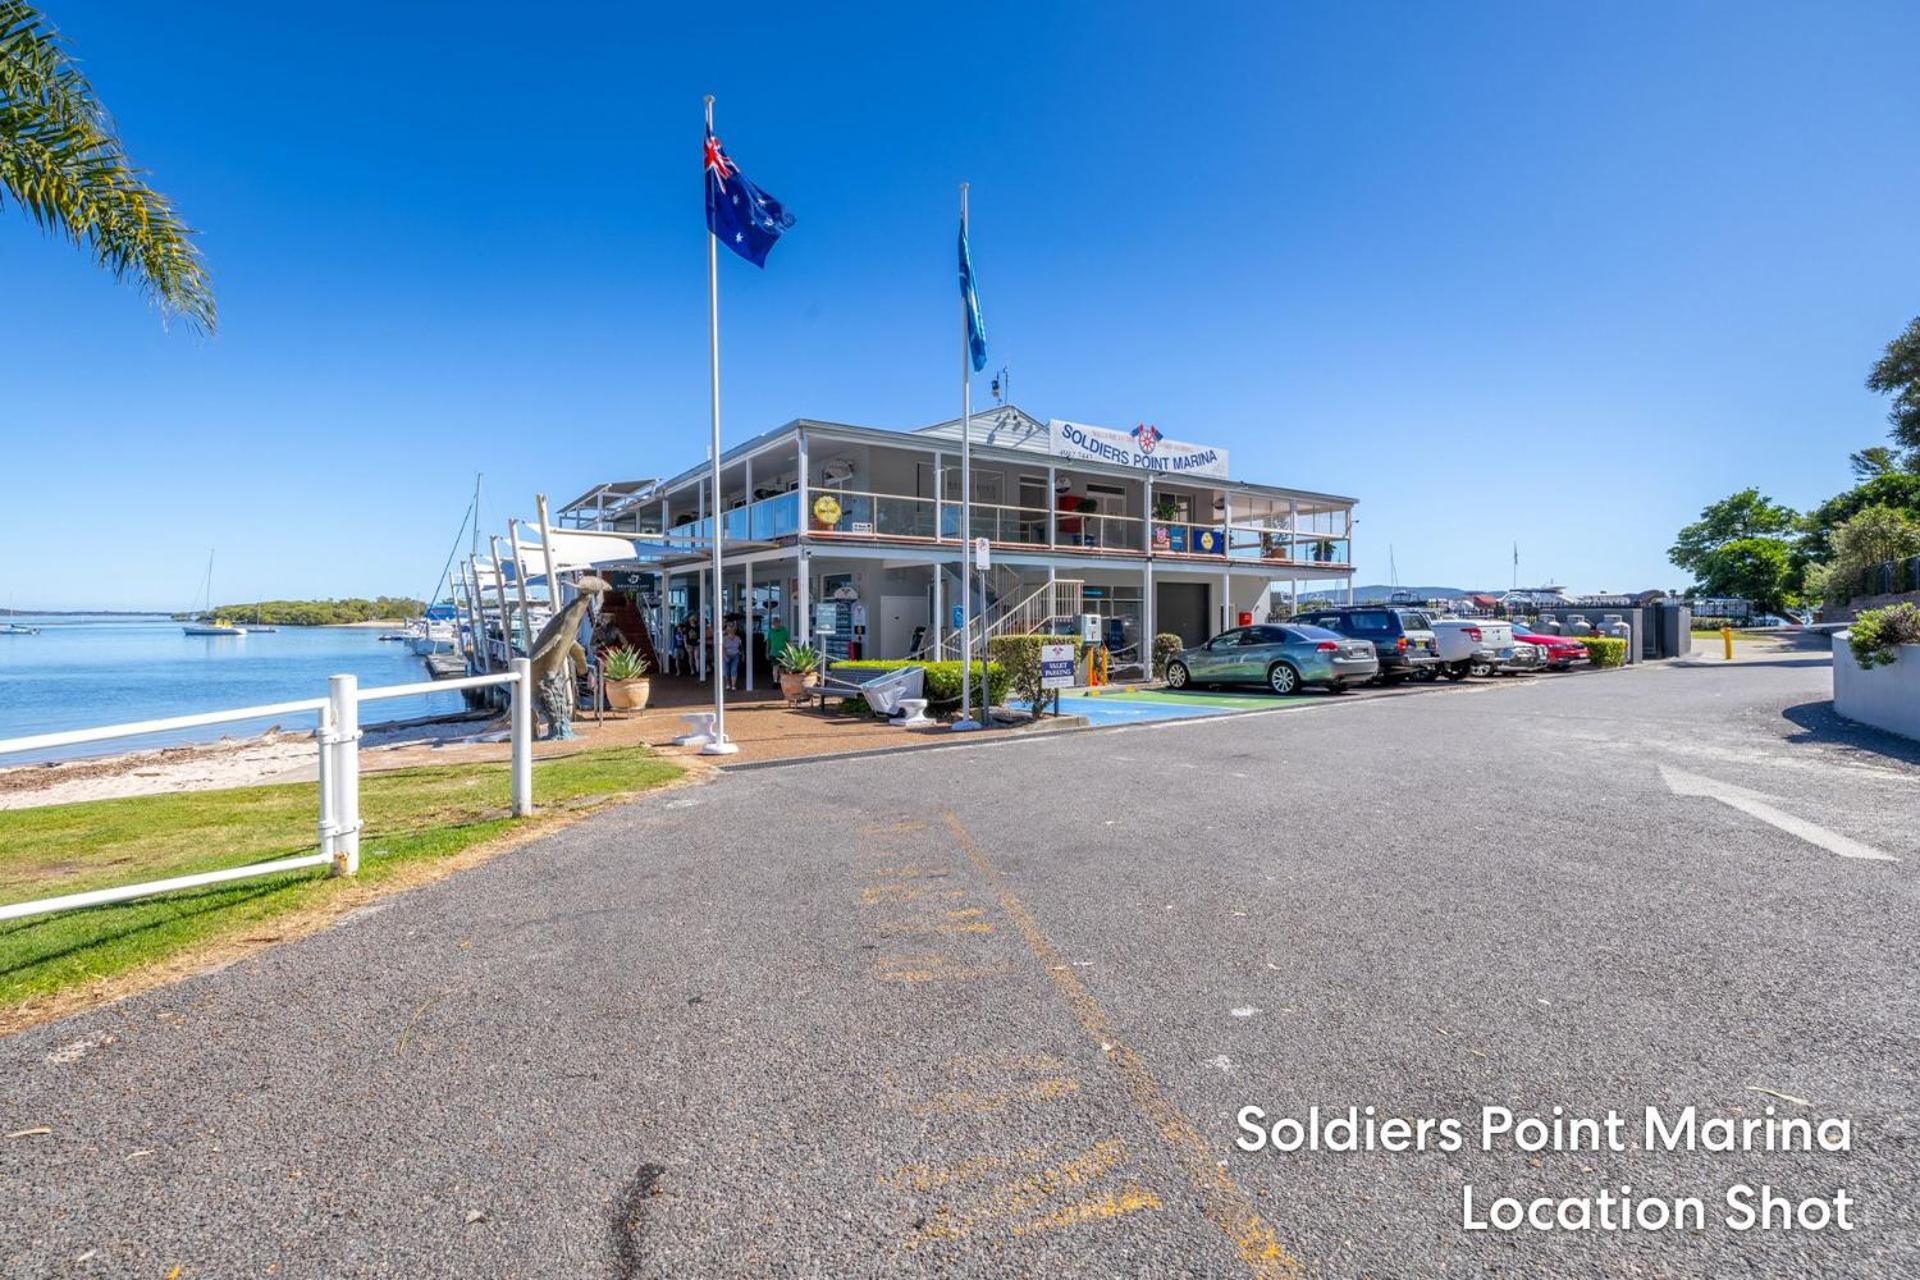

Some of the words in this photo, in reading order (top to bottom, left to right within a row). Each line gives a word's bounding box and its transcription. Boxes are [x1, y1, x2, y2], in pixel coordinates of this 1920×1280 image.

[1062, 424, 1130, 465] SOLDIERS
[1133, 454, 1170, 471] POINT
[1173, 449, 1218, 471] MARINA
[1045, 668, 1072, 676] PARKING
